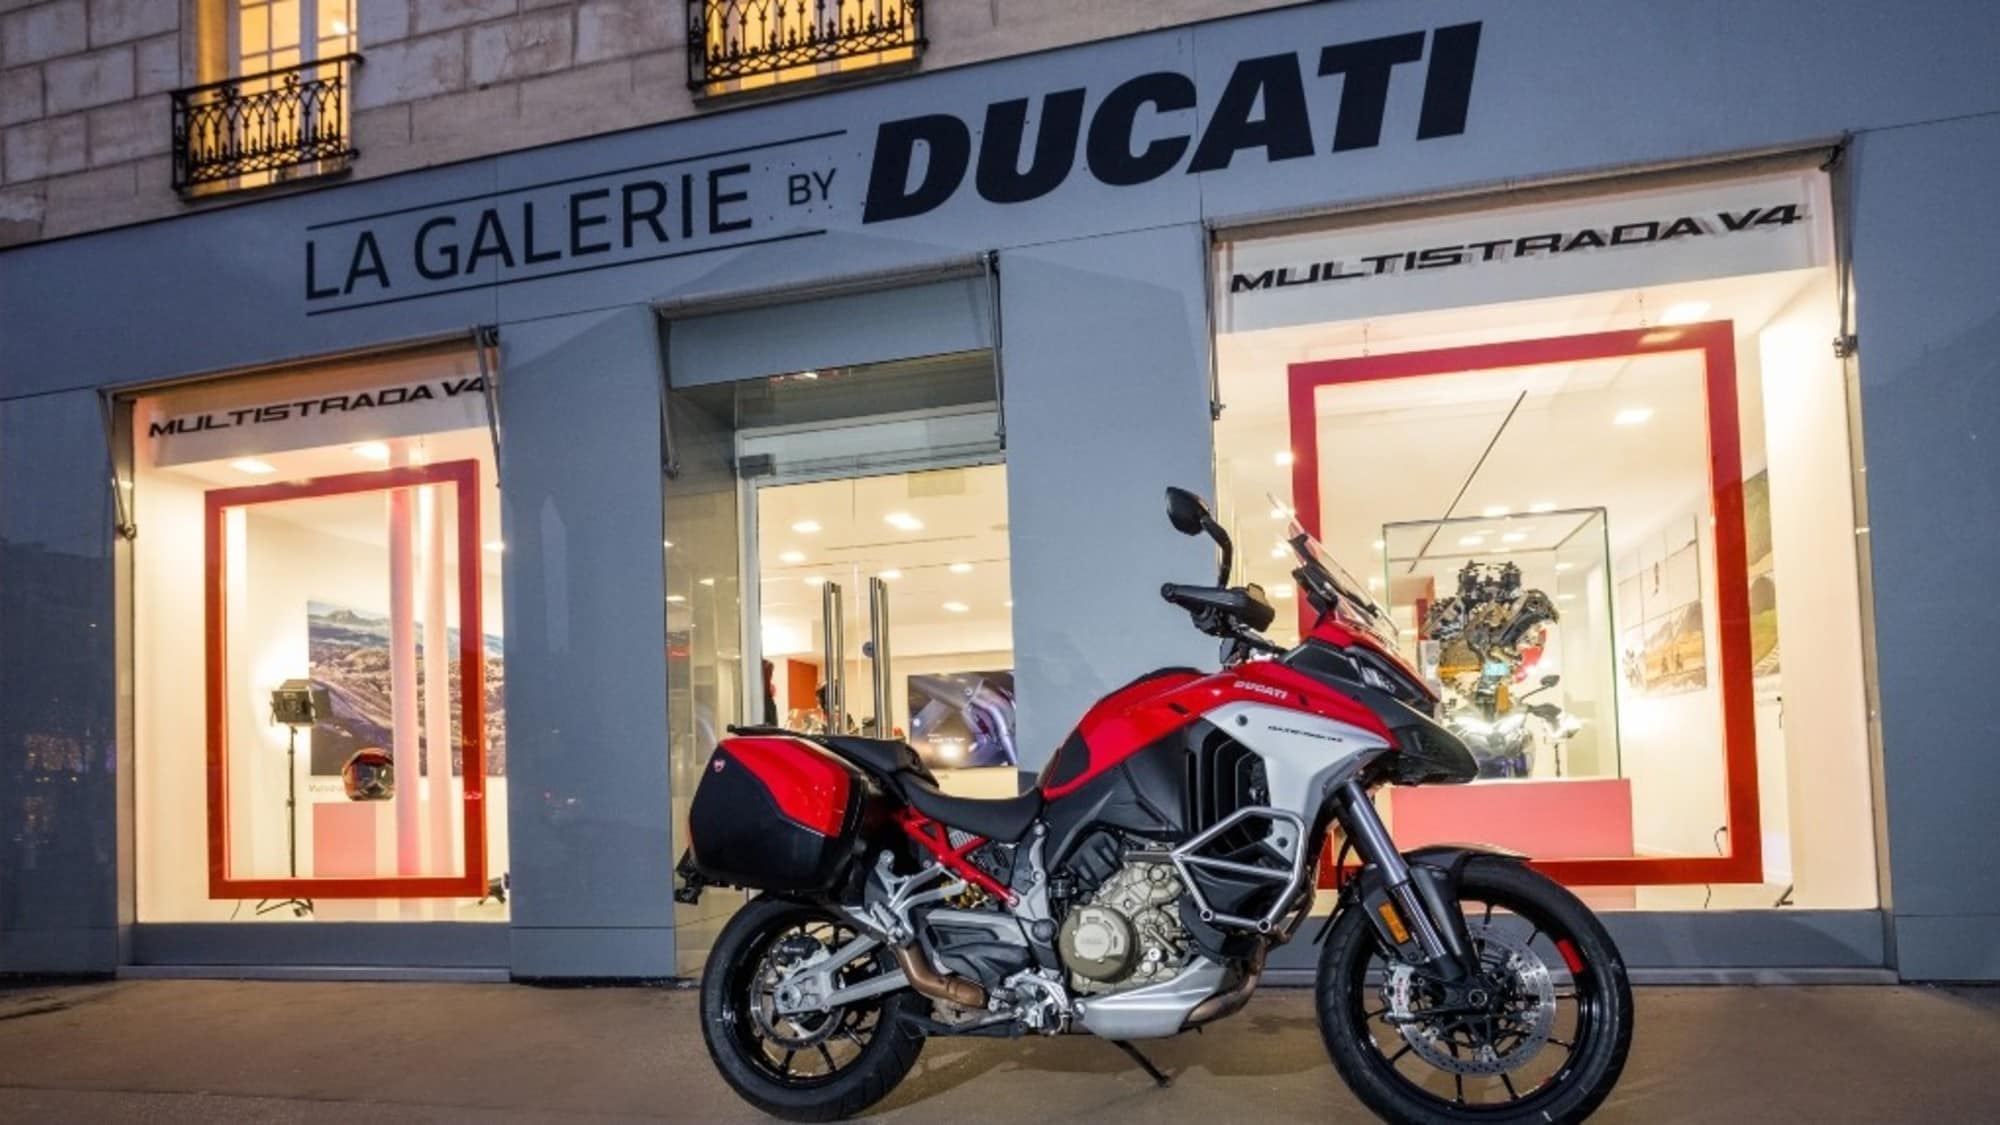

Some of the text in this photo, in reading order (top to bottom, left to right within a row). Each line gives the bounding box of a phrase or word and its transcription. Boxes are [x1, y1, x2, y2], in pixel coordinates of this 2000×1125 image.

[306, 20, 1483, 301] LA GALERIE BY DUCATI
[1230, 203, 1803, 293] MULTISTRADA V4
[149, 376, 486, 437] MULTISTRADA V4
[1233, 680, 1289, 700] DUCATI
